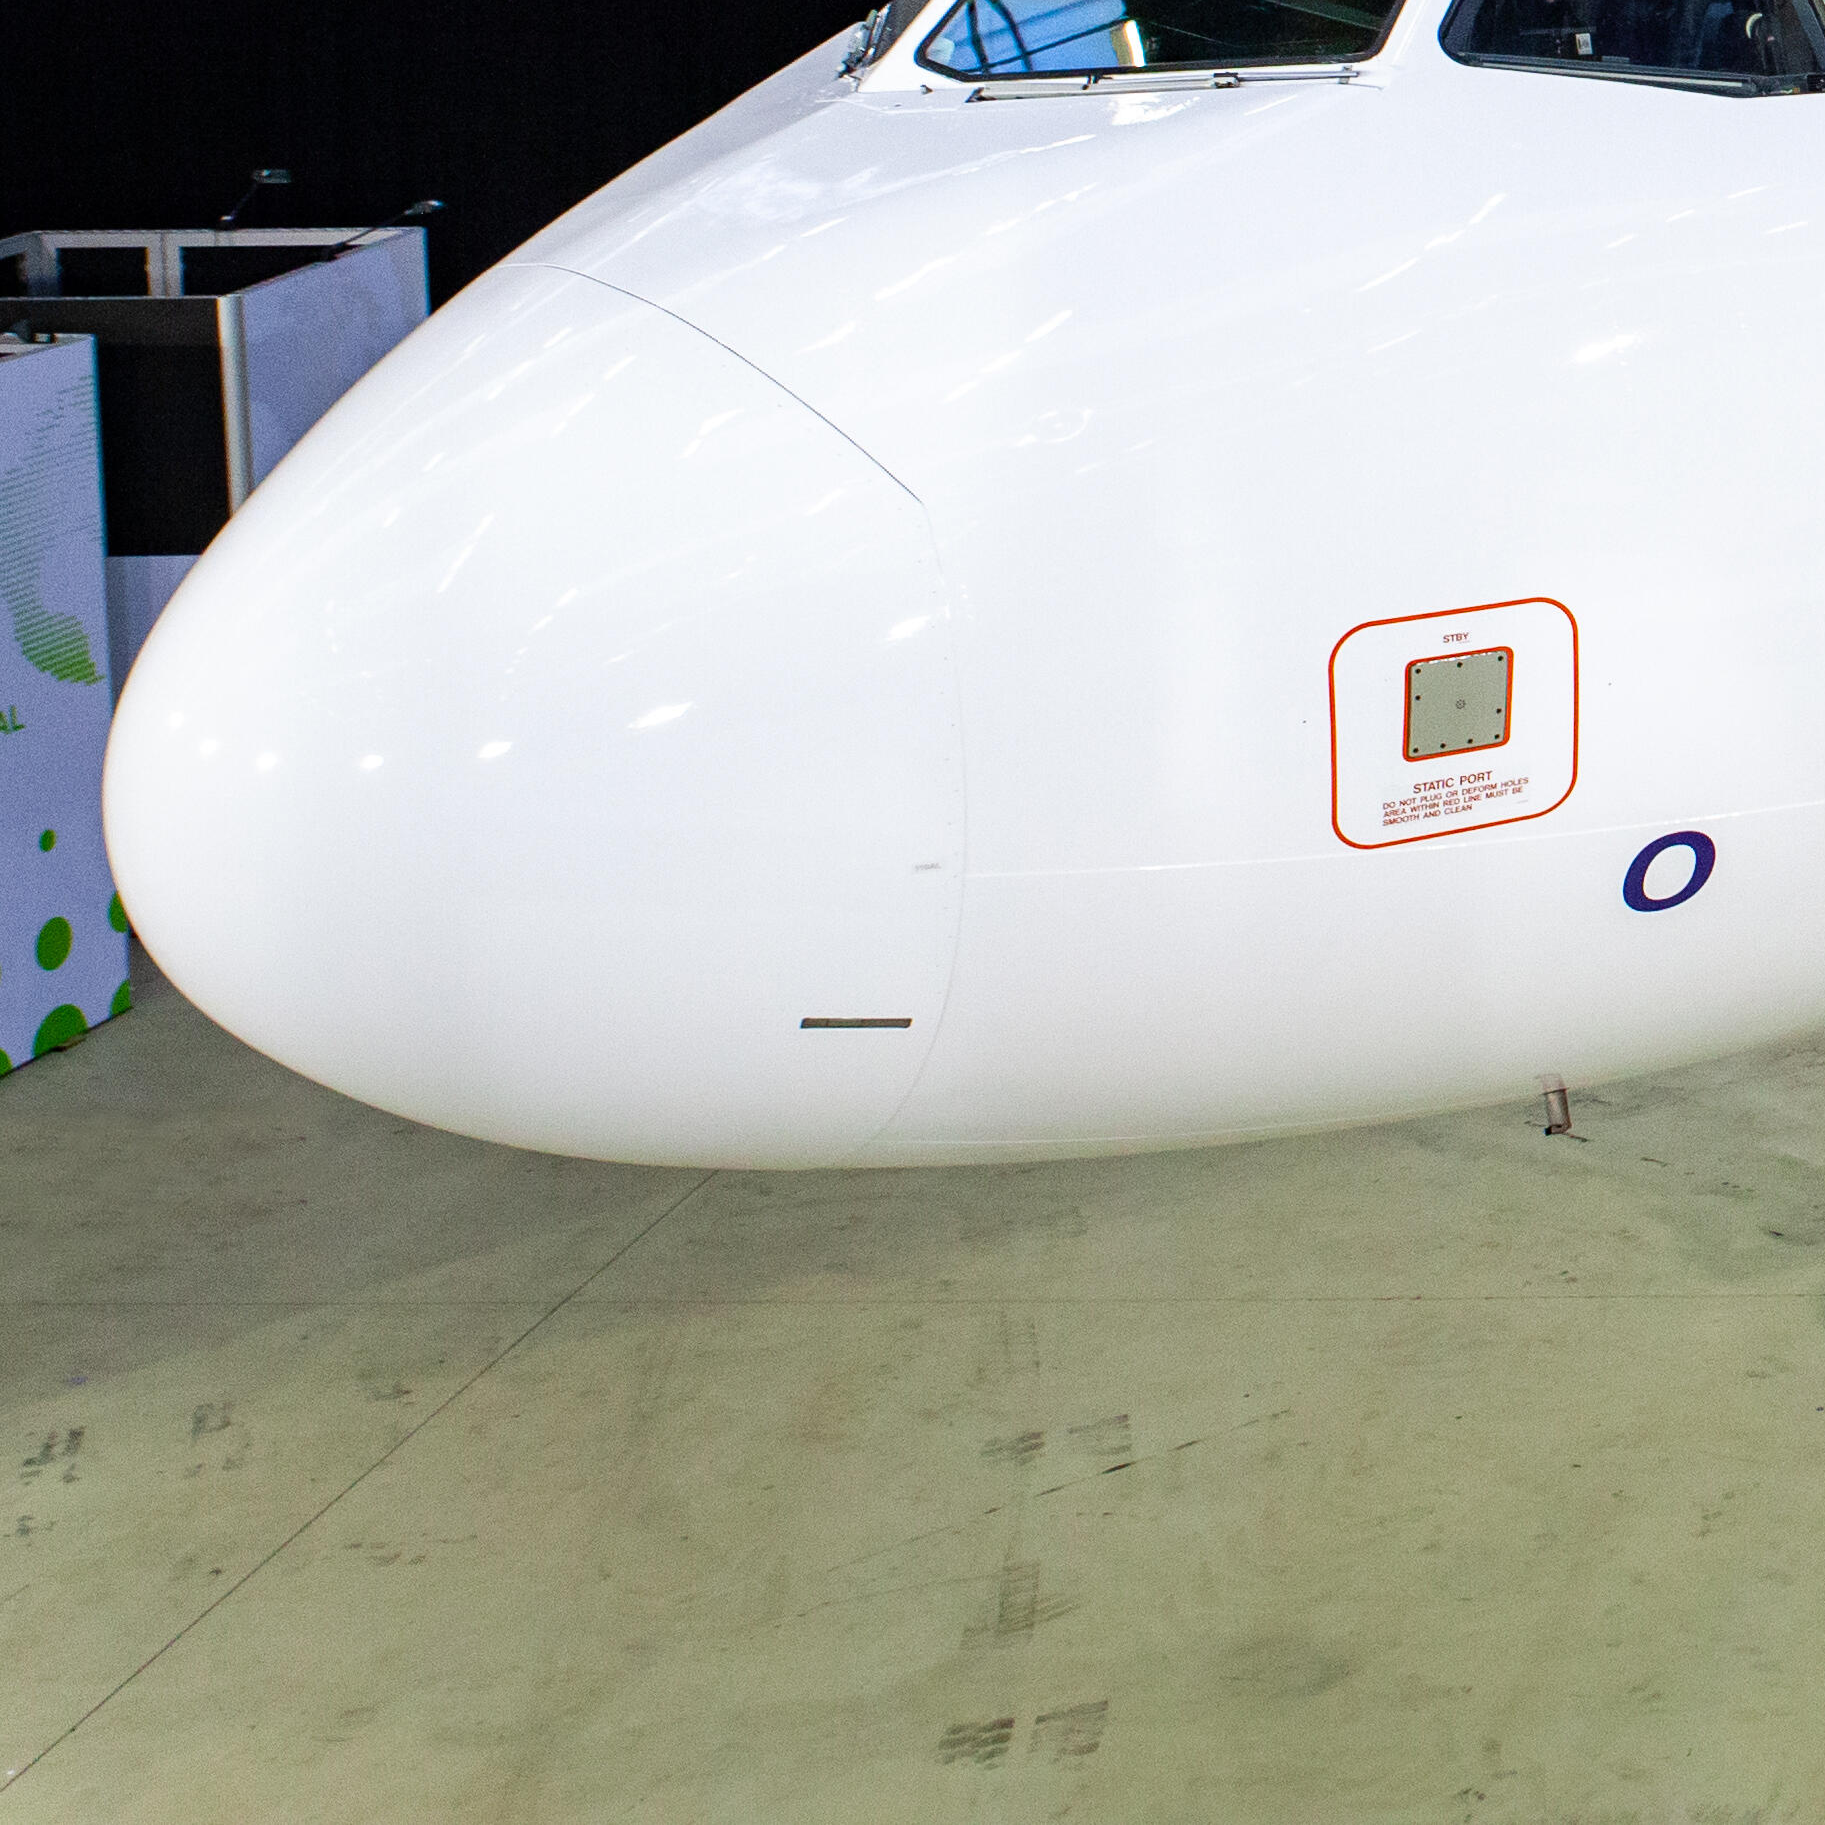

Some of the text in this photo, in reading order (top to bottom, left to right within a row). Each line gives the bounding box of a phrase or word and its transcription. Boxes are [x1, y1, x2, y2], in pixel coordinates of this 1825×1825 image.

[1443, 632, 1469, 643] STBY
[1382, 777, 1529, 810] DO NOT PLUG OR DEFORM HOLES
[1413, 770, 1493, 794] STATIC PORT
[1383, 785, 1524, 817] AREA WITHIN RED LINE MUST BE
[1382, 804, 1473, 826] SMOOTH AND CLEAN
